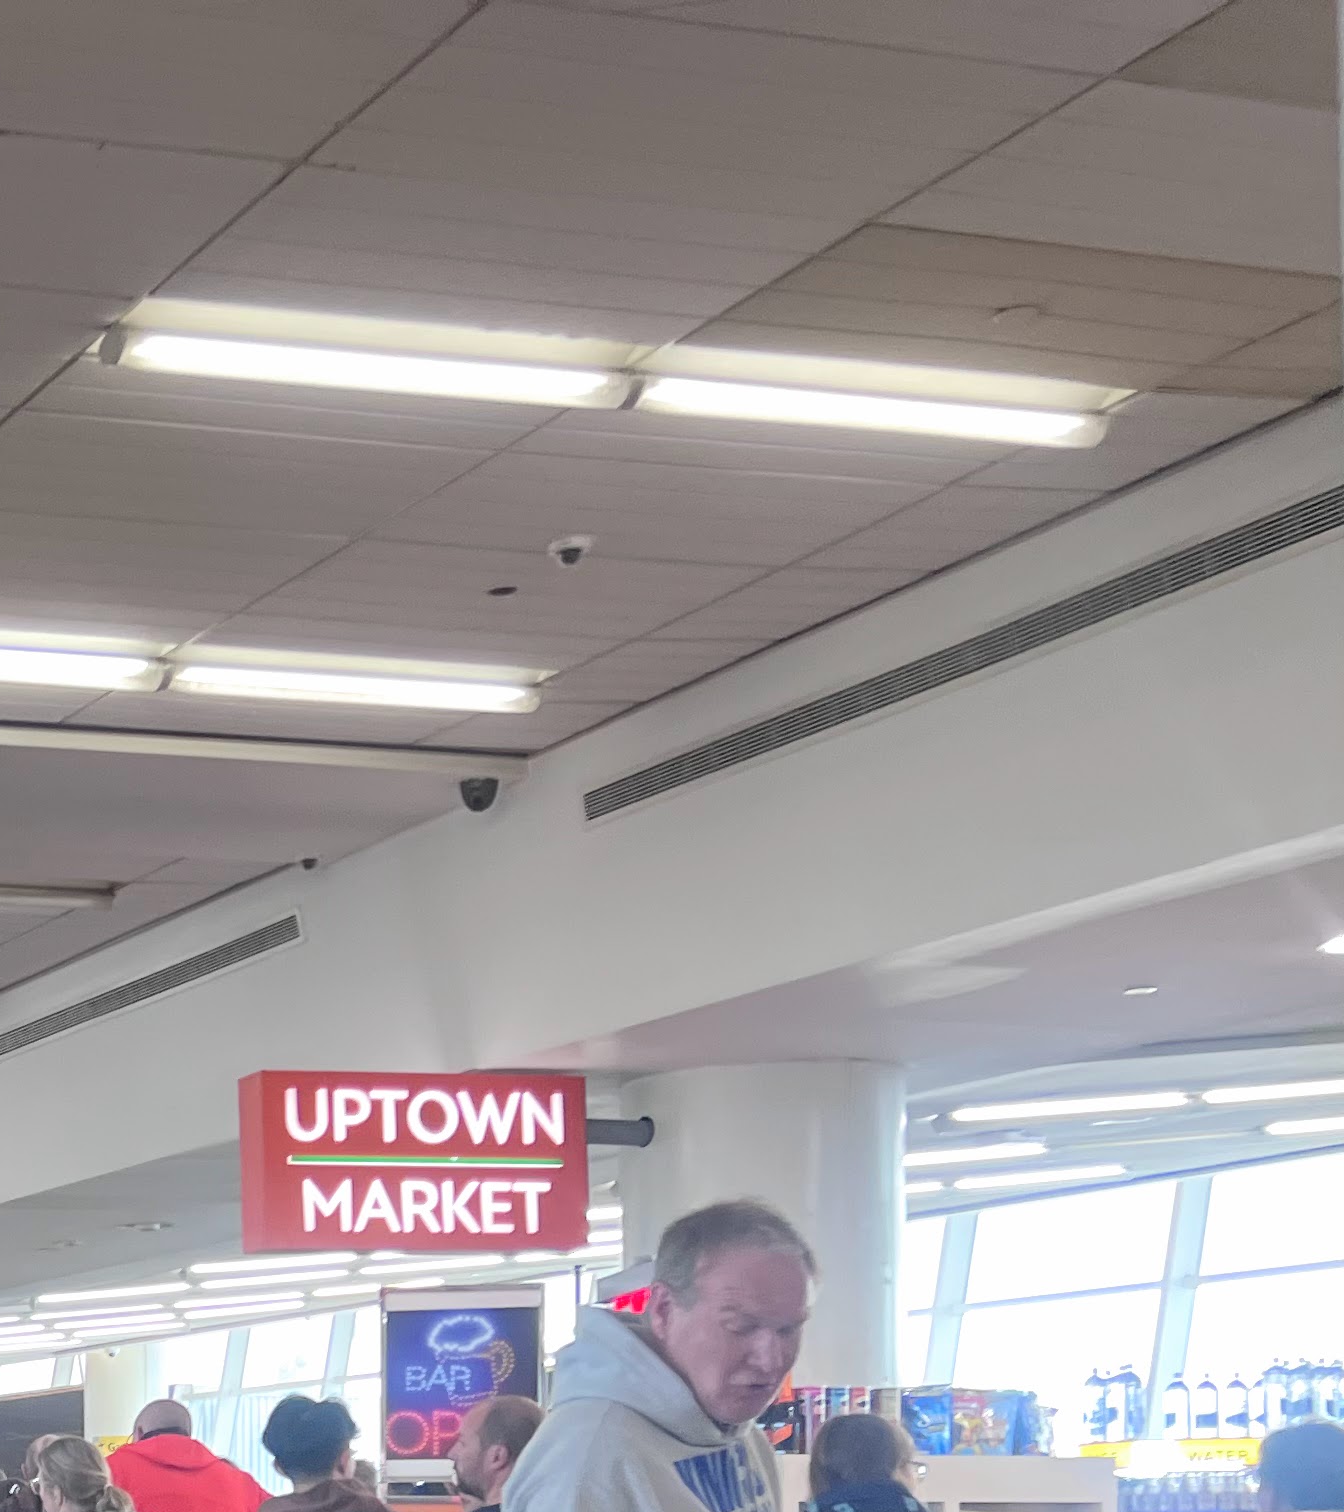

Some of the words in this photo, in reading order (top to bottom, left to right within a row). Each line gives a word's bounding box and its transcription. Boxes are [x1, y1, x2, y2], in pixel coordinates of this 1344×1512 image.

[284, 1087, 565, 1146] UPTOWN
[301, 1177, 552, 1234] MARKET
[405, 1364, 472, 1392] BAR
[385, 1410, 462, 1457] OP
